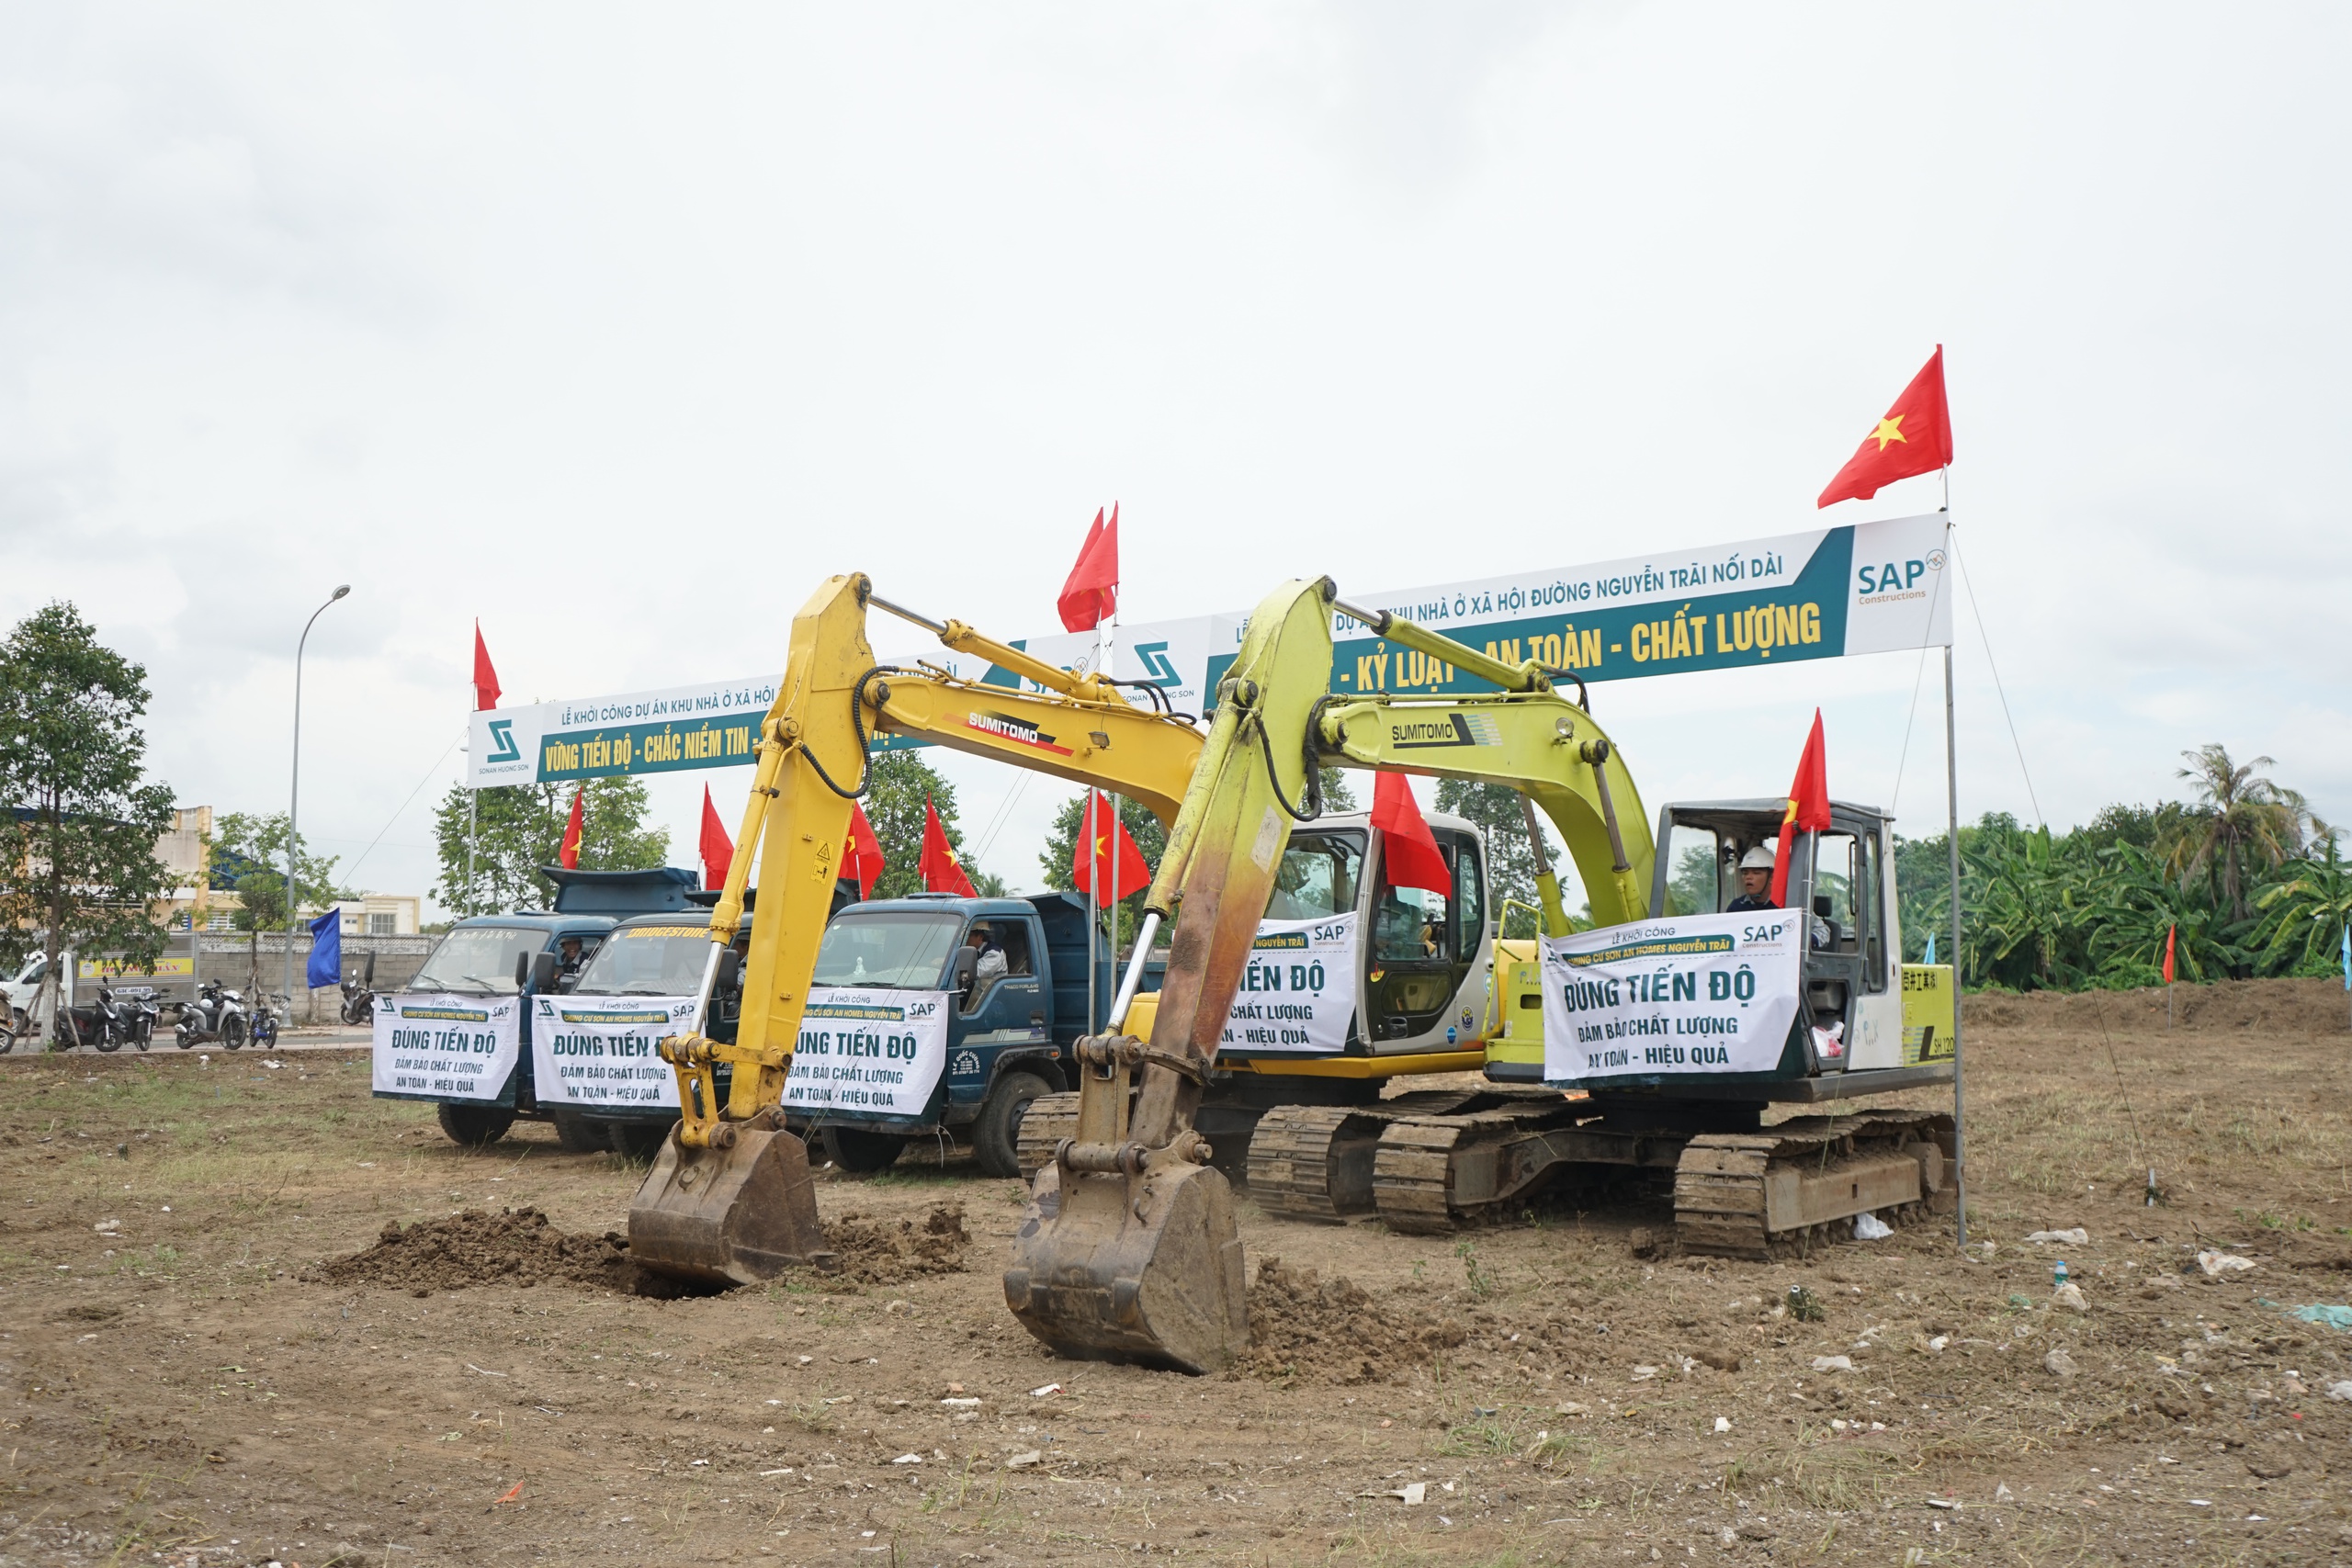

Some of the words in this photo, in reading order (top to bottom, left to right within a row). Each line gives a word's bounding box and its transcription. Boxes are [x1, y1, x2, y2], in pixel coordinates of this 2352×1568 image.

[1418, 596, 1449, 622] NHÀ
[1454, 592, 1466, 616] Ở
[1471, 592, 1493, 615] XÃ
[1498, 586, 1525, 615] HỘI
[1531, 581, 1591, 607] ĐƯỜNG
[1597, 564, 1664, 598] NGUYỄN
[1669, 562, 1706, 589] TRÃI
[1713, 552, 1745, 583] NỐI
[1751, 551, 1782, 579] DÀI
[1859, 559, 1925, 595] SAP
[1859, 591, 1927, 605] Constructions
[1357, 642, 1389, 692] KỶ
[1528, 624, 1602, 671] TOÀN
[1631, 604, 1707, 662] CHẤT
[1716, 602, 1821, 658] LƯỢNG
[1178, 690, 1194, 698] SON
[561, 707, 571, 726] LỄ
[574, 705, 597, 724] KHỞI
[601, 704, 632, 721] CÔNG
[636, 701, 650, 720] DỰ
[652, 698, 667, 715] ÁN
[671, 698, 693, 714] KHU
[695, 693, 718, 710] NHÀ
[722, 689, 731, 707] Ở
[734, 688, 751, 706] XÃ
[754, 685, 775, 706] HỘI
[968, 712, 1038, 744] SUMITOMO
[1392, 723, 1453, 741] SUMITOMO
[545, 740, 579, 773] VỮNG
[582, 732, 611, 769] TIẾN
[613, 732, 632, 771] ĐỘ
[644, 724, 682, 763] CHẮC
[684, 722, 722, 760] NIỀM
[725, 727, 749, 756] TIN
[497, 765, 517, 773] HUONG
[626, 926, 711, 939] BRIDGESTONE
[1256, 935, 1286, 948] NGUYỄN
[1287, 936, 1305, 947] TRÃI
[1314, 925, 1344, 941] SAP
[1611, 931, 1620, 945] LỄ
[1622, 928, 1643, 943] KHỞI
[1645, 926, 1676, 939] CÔNG
[1743, 924, 1782, 942] SAP
[1623, 947, 1634, 959] AN
[1636, 944, 1667, 956] HOMES
[1668, 938, 1707, 953] NGUYỄN
[1708, 938, 1730, 952] TRÃI
[1239, 956, 1282, 992] IẾN
[1290, 959, 1325, 998] ĐỘ
[1564, 976, 1620, 1013] ĐÚNG
[1626, 964, 1696, 1003] TIẾN
[1708, 964, 1756, 1008] ĐỘ
[852, 995, 871, 1004] CÔNG
[909, 1002, 936, 1016] SAP
[492, 1007, 510, 1018] SAP
[605, 1014, 614, 1022] AN
[615, 1015, 632, 1023] HOMES
[673, 1005, 695, 1017] SAP
[834, 1009, 845, 1018] AN
[845, 1010, 864, 1019] HOMES
[1230, 1000, 1262, 1020] CHẤT
[1267, 1004, 1313, 1022] LƯỢNG
[1246, 1027, 1276, 1046] HIỆU
[1281, 1025, 1310, 1044] QUẢ
[1577, 1021, 1603, 1043] ĐẢM
[1607, 1017, 1627, 1040] BẢO
[1629, 1012, 1669, 1036] CHẤT
[1676, 1016, 1738, 1038] LƯỢNG
[391, 1026, 430, 1050] ĐÚNG
[435, 1026, 469, 1052] TIẾN
[473, 1031, 496, 1058] ĐỘ
[553, 1030, 604, 1056] ĐÚNG
[608, 1029, 649, 1057] TIẾN
[795, 1027, 830, 1055] ÚNG
[836, 1026, 880, 1057] TIẾN
[887, 1032, 917, 1065] ĐỘ
[1645, 1043, 1685, 1067] HIỆU
[1690, 1042, 1730, 1066] QUẢ
[394, 1055, 412, 1069] ĐẢM
[413, 1056, 429, 1070] BẢO
[430, 1057, 452, 1073] CHẤT
[453, 1061, 484, 1076] LƯỢNG
[560, 1062, 584, 1078] ĐẢM
[587, 1063, 605, 1079] BẢO
[607, 1064, 633, 1079] CHẤT
[636, 1066, 666, 1082] LƯỢNG
[787, 1062, 809, 1078] ĐẢM
[812, 1063, 830, 1079] BẢO
[832, 1063, 862, 1081] CHẤT
[865, 1069, 904, 1086] LƯỢNG
[395, 1077, 407, 1088] AN
[408, 1076, 427, 1089] TOÀN
[435, 1077, 453, 1093] HIỆU
[456, 1078, 474, 1093] QUẢ
[582, 1085, 607, 1099] TOÀN
[616, 1085, 638, 1101] HIỆU
[639, 1085, 660, 1101] QUẢ
[789, 1087, 803, 1100] AN
[808, 1086, 831, 1101] TOÀN
[842, 1088, 868, 1106] HIỆU
[872, 1089, 894, 1106] QUẢ
